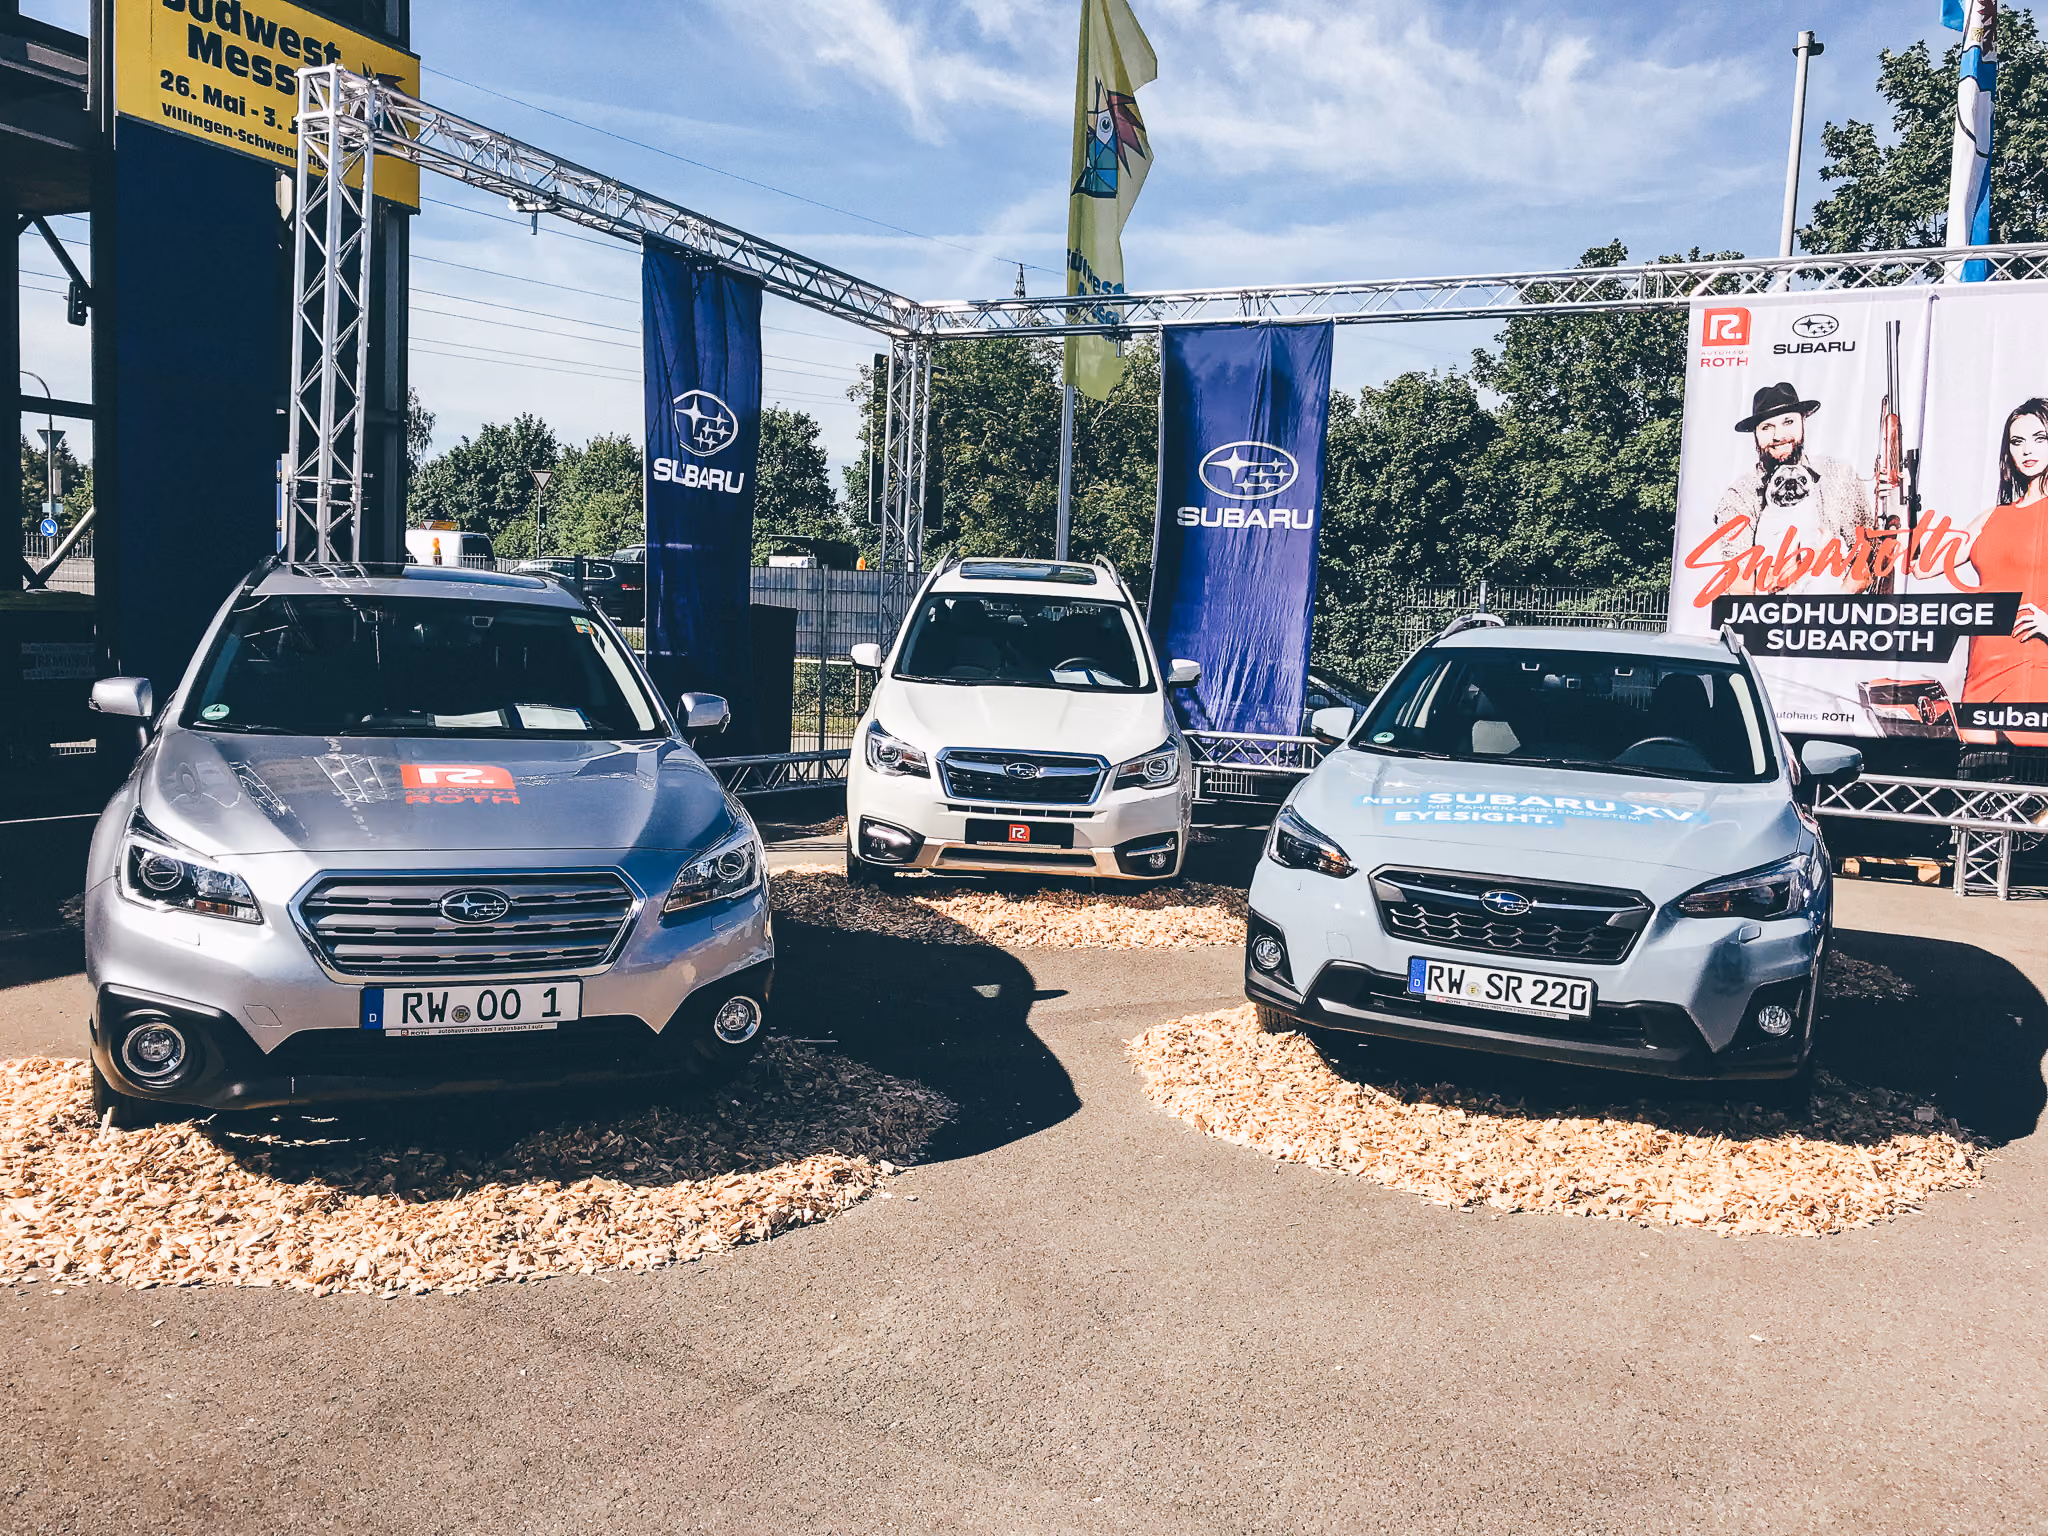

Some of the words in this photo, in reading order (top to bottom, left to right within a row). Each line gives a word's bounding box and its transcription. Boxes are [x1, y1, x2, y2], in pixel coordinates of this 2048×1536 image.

[188, 23, 310, 101] Mess
[160, 69, 197, 100] 26.
[203, 84, 246, 117] Mai
[264, 105, 283, 130] 3.
[1773, 341, 1856, 354] SUBARU
[1701, 357, 1748, 367] ROTH
[653, 458, 745, 493] SUBARU
[1177, 506, 1314, 530] SUBARU
[1724, 602, 1994, 626] JAGDHUNDBEIGE
[1766, 630, 1934, 652] SUBAROTH
[1776, 711, 1819, 721] utohaus
[1821, 712, 1855, 722] ROTH
[1427, 793, 1616, 812] SUBARU
[1628, 803, 1694, 821] XV
[1413, 978, 1420, 987] D
[1427, 965, 1465, 995] RW
[1485, 973, 1522, 1003] SR
[1530, 979, 1587, 1011] 220
[369, 1013, 377, 1022] D
[401, 991, 448, 1024] RW
[541, 987, 562, 1018] 1
